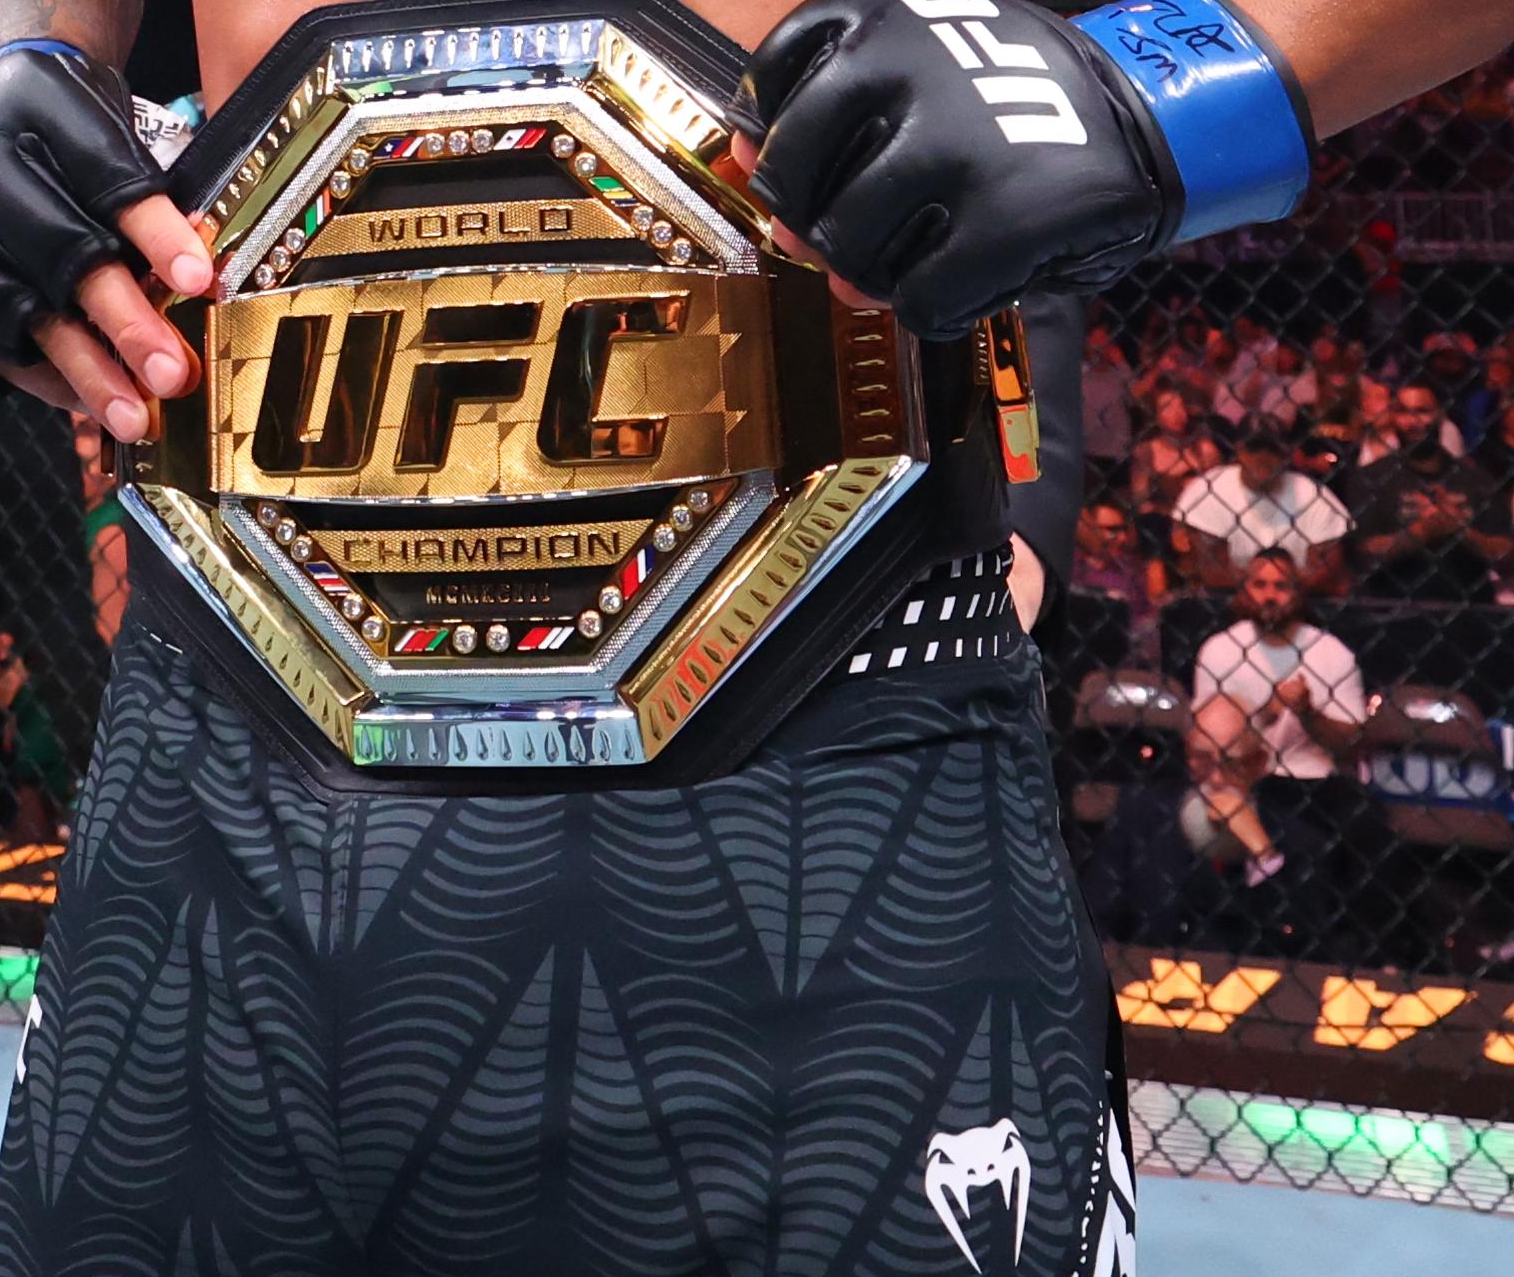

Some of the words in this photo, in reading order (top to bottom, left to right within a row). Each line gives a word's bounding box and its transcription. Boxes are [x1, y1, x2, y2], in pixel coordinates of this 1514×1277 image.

[368, 207, 574, 244] WORLD
[251, 289, 691, 474] UFC
[343, 530, 621, 566] CHAMPION
